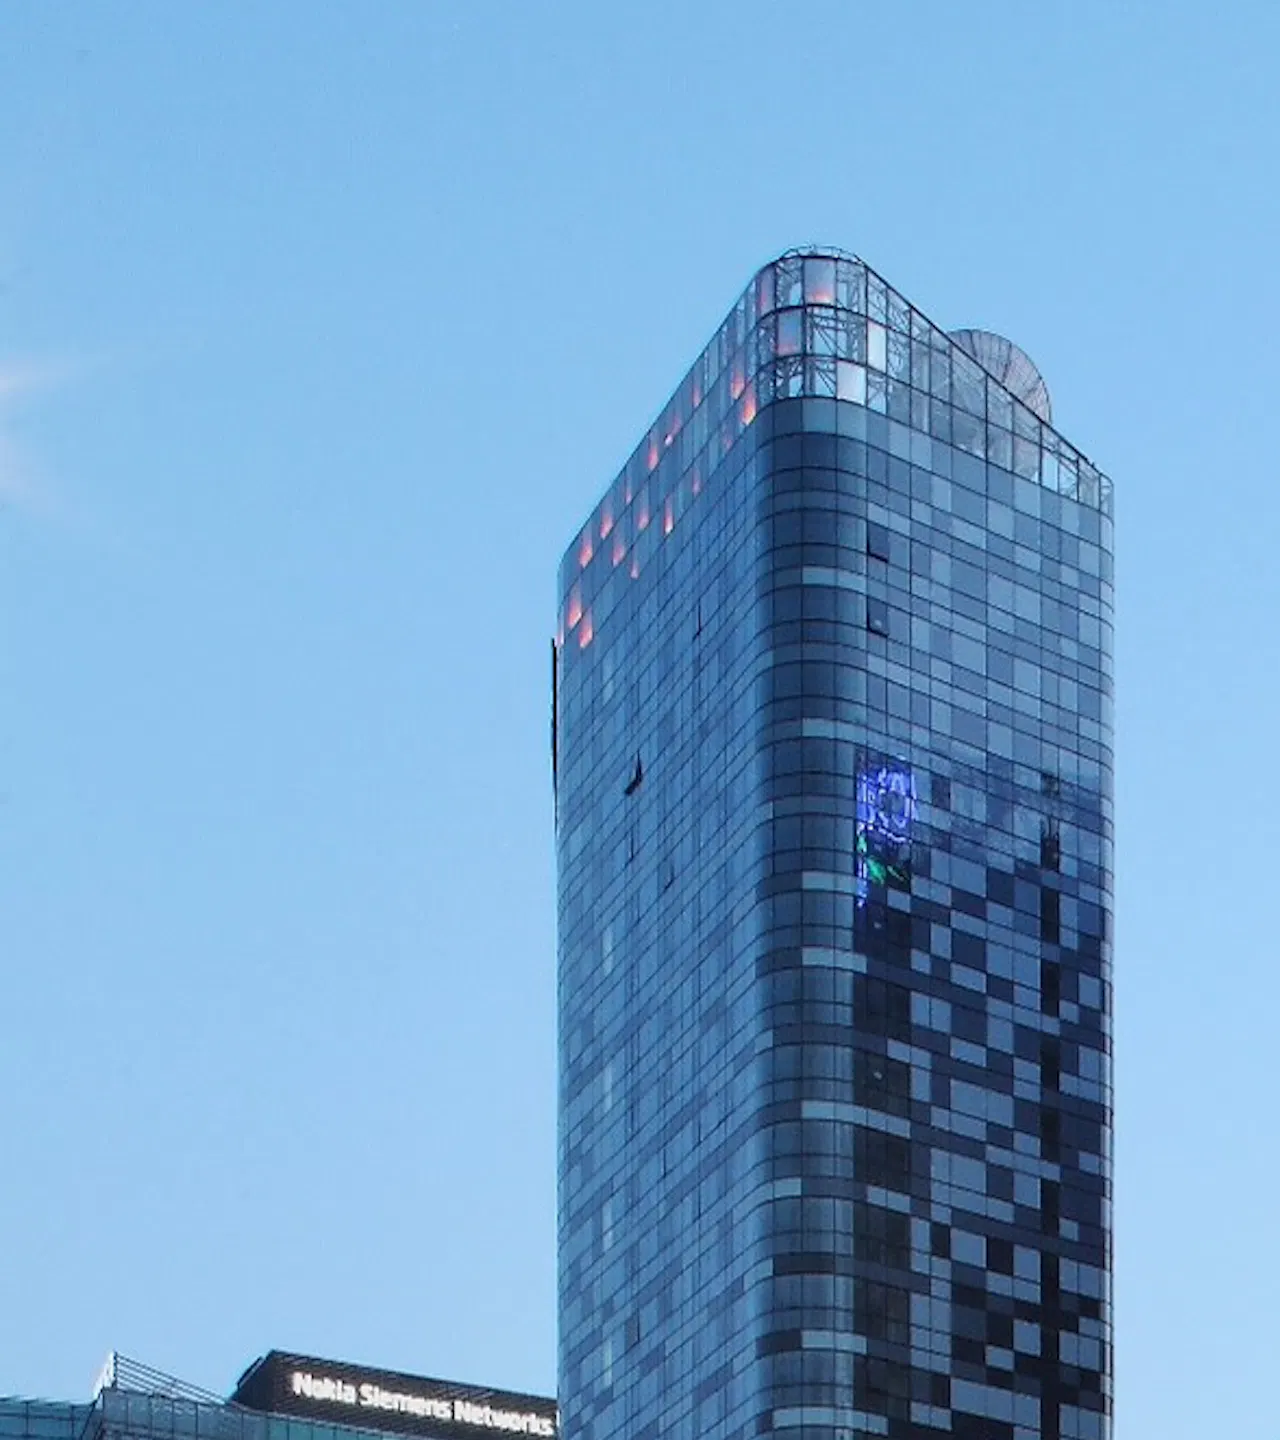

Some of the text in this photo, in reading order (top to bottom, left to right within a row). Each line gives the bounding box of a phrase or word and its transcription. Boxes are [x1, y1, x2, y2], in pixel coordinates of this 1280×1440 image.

[292, 1371, 555, 1437] Nokia Siemens Networks
